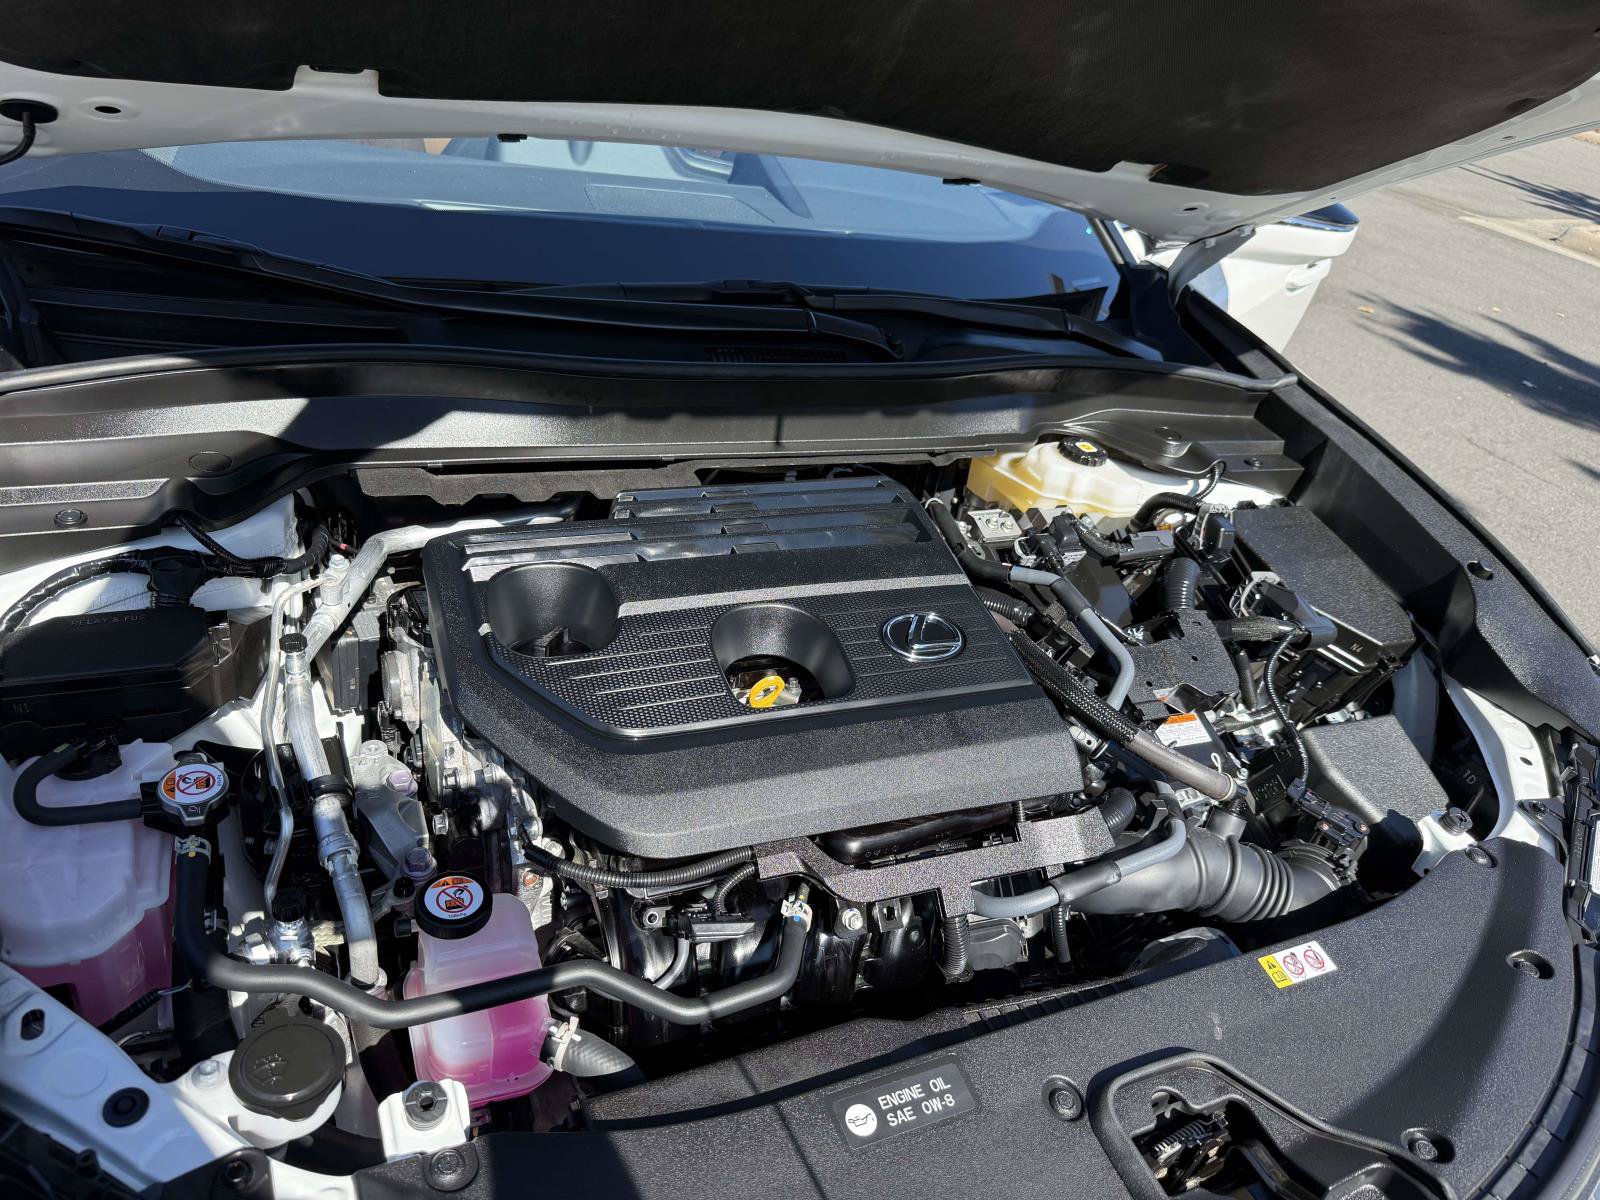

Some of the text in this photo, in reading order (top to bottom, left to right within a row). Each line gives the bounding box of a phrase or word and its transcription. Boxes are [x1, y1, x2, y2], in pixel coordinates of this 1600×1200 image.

[72, 617, 109, 626] RELAY
[878, 1076, 951, 1110] ENGINE OIL
[886, 1093, 955, 1127] SAE 0W-8
